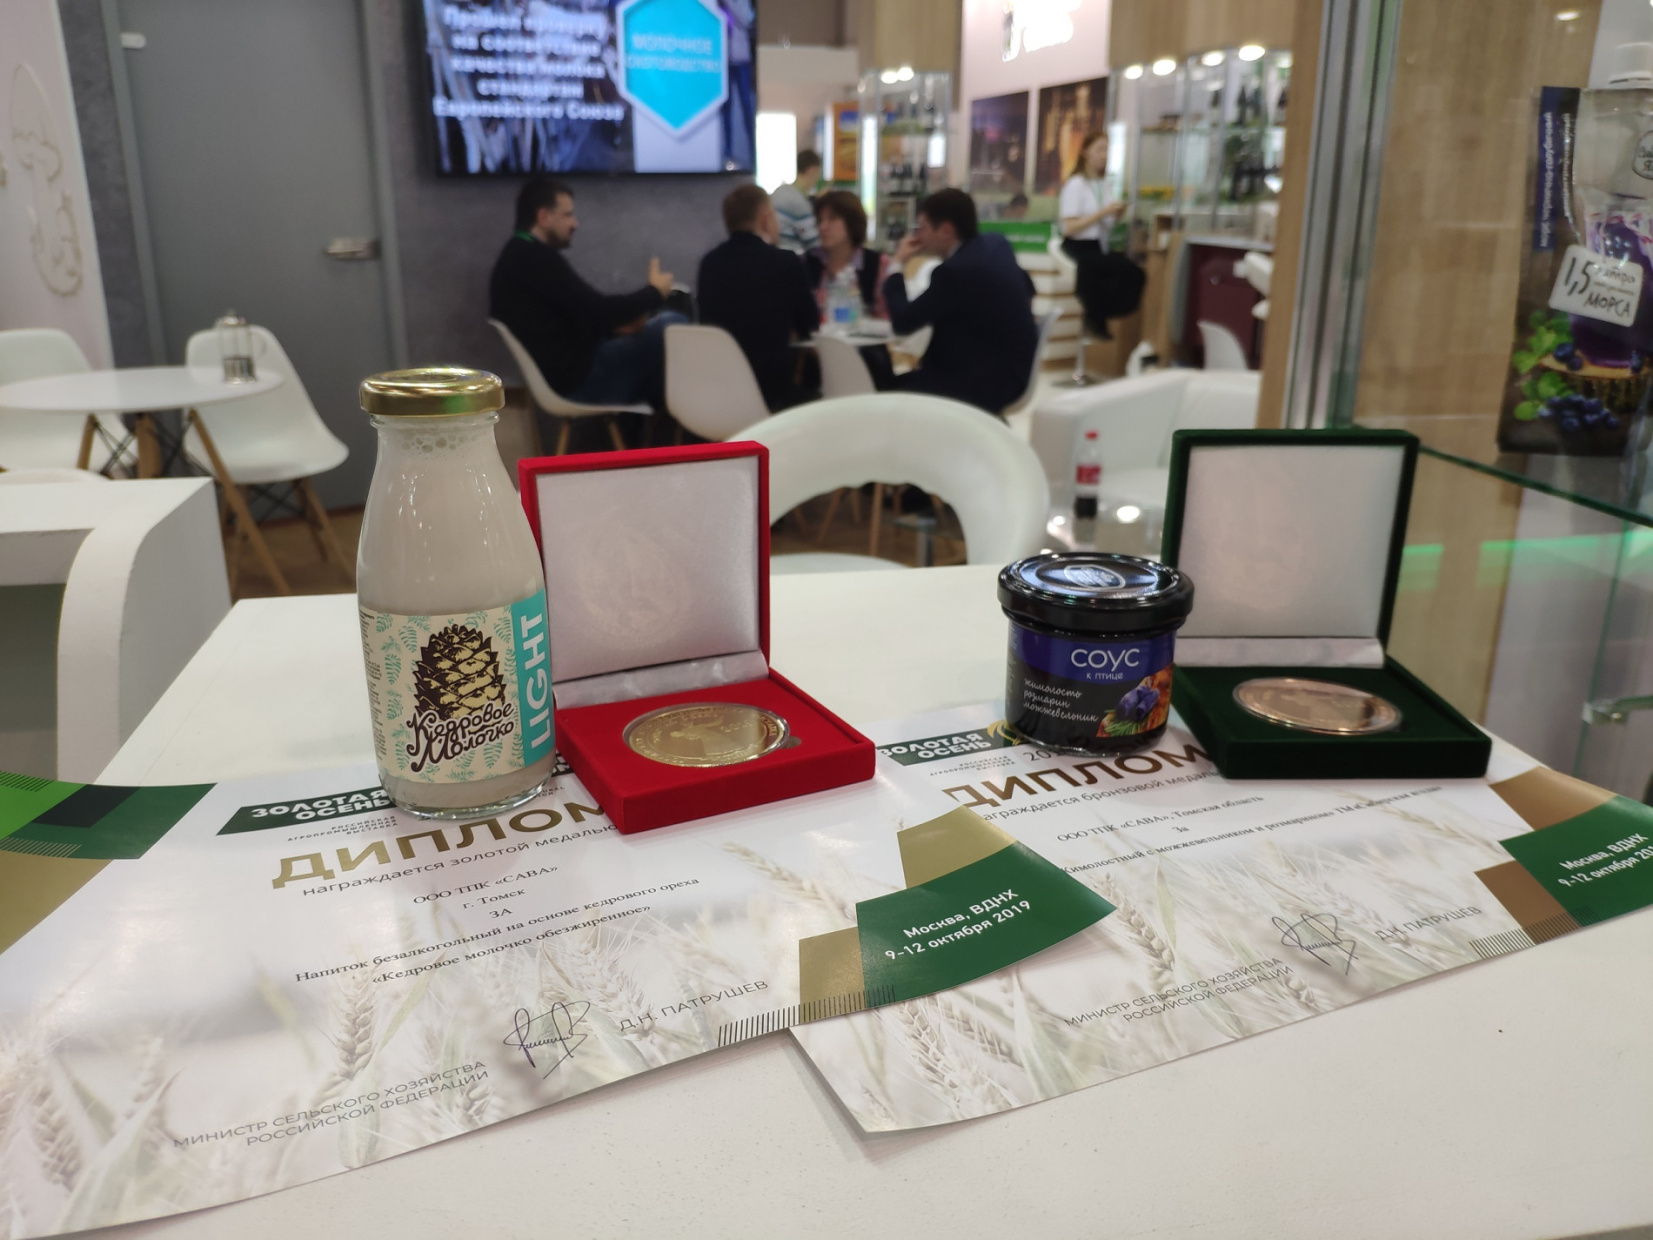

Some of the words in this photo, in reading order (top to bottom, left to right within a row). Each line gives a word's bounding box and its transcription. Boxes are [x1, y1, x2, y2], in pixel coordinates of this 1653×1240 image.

[632, 34, 712, 55] МОЛОЧНОЕ
[433, 97, 565, 119] Европейского
[567, 101, 624, 120] Союза
[1564, 257, 1595, 296] 1,5
[521, 613, 550, 749] LIGHT
[1024, 677, 1082, 698] жимолость
[1086, 672, 1092, 680] к
[1095, 672, 1123, 681] птице
[1023, 690, 1071, 708] розмарин
[1023, 701, 1099, 723] можжевельник
[879, 733, 983, 758] ЗОЛОТАЯ
[918, 741, 992, 759] ОСЕНЬ
[251, 789, 388, 818] ЗОЛОТАЯ
[295, 799, 391, 820] ОСЕНЬ
[984, 796, 1080, 821] аграждается
[1081, 779, 1164, 801] бронзовой
[1165, 771, 1220, 786] медаль
[1057, 829, 1088, 842] ООО
[1088, 824, 1118, 837] ТПК
[1174, 804, 1221, 819] Томская
[1156, 829, 1255, 853] можжевельником
[302, 861, 445, 896] награждается
[451, 842, 529, 866] золотой
[535, 824, 618, 843] медалью
[1559, 850, 1614, 870] Москва,
[1606, 832, 1649, 854] ВДНХ
[1590, 856, 1641, 878] октября
[413, 890, 452, 904] ООО
[455, 881, 490, 895] ТПК
[495, 866, 558, 885] «САВА»
[462, 902, 474, 910] г.
[481, 889, 526, 906] Томск
[295, 960, 369, 982] Напиток
[373, 927, 502, 965] безалкогольный
[506, 922, 525, 932] на
[528, 907, 580, 926] основе
[584, 887, 657, 910] кедрового
[660, 878, 700, 893] ореха
[489, 907, 513, 919] ЗА
[903, 913, 970, 939] Москва,
[969, 889, 1019, 916] ВДНХ
[928, 919, 993, 948] октября
[992, 900, 1031, 923] 2019
[1403, 906, 1483, 931] ПАТРУШЕВ
[373, 956, 460, 984] «Кедровое
[464, 938, 532, 962] молочко
[536, 905, 651, 940] обезжиренное»
[619, 1013, 658, 1032] Д.Н.
[661, 980, 769, 1017] ПАТРУШЕВ
[1064, 1002, 1130, 1027] МИНИСТР
[1133, 980, 1209, 1008] СЕЛЬСКОГО
[1208, 957, 1284, 985] ХОЗЯЙСТВА
[1123, 990, 1216, 1023] РОССИЙСКОЙ
[1215, 966, 1294, 996] ФЕДЕРАЦИИ
[173, 1121, 268, 1148] МИНИСТР
[272, 1092, 380, 1127] СЕЛЬСКОГО
[384, 1060, 486, 1097] ХОЗЯЙСТВА
[247, 1104, 375, 1146] РОССИЙСКОЙ
[380, 1070, 489, 1109] ФЕДЕРАЦИИ
